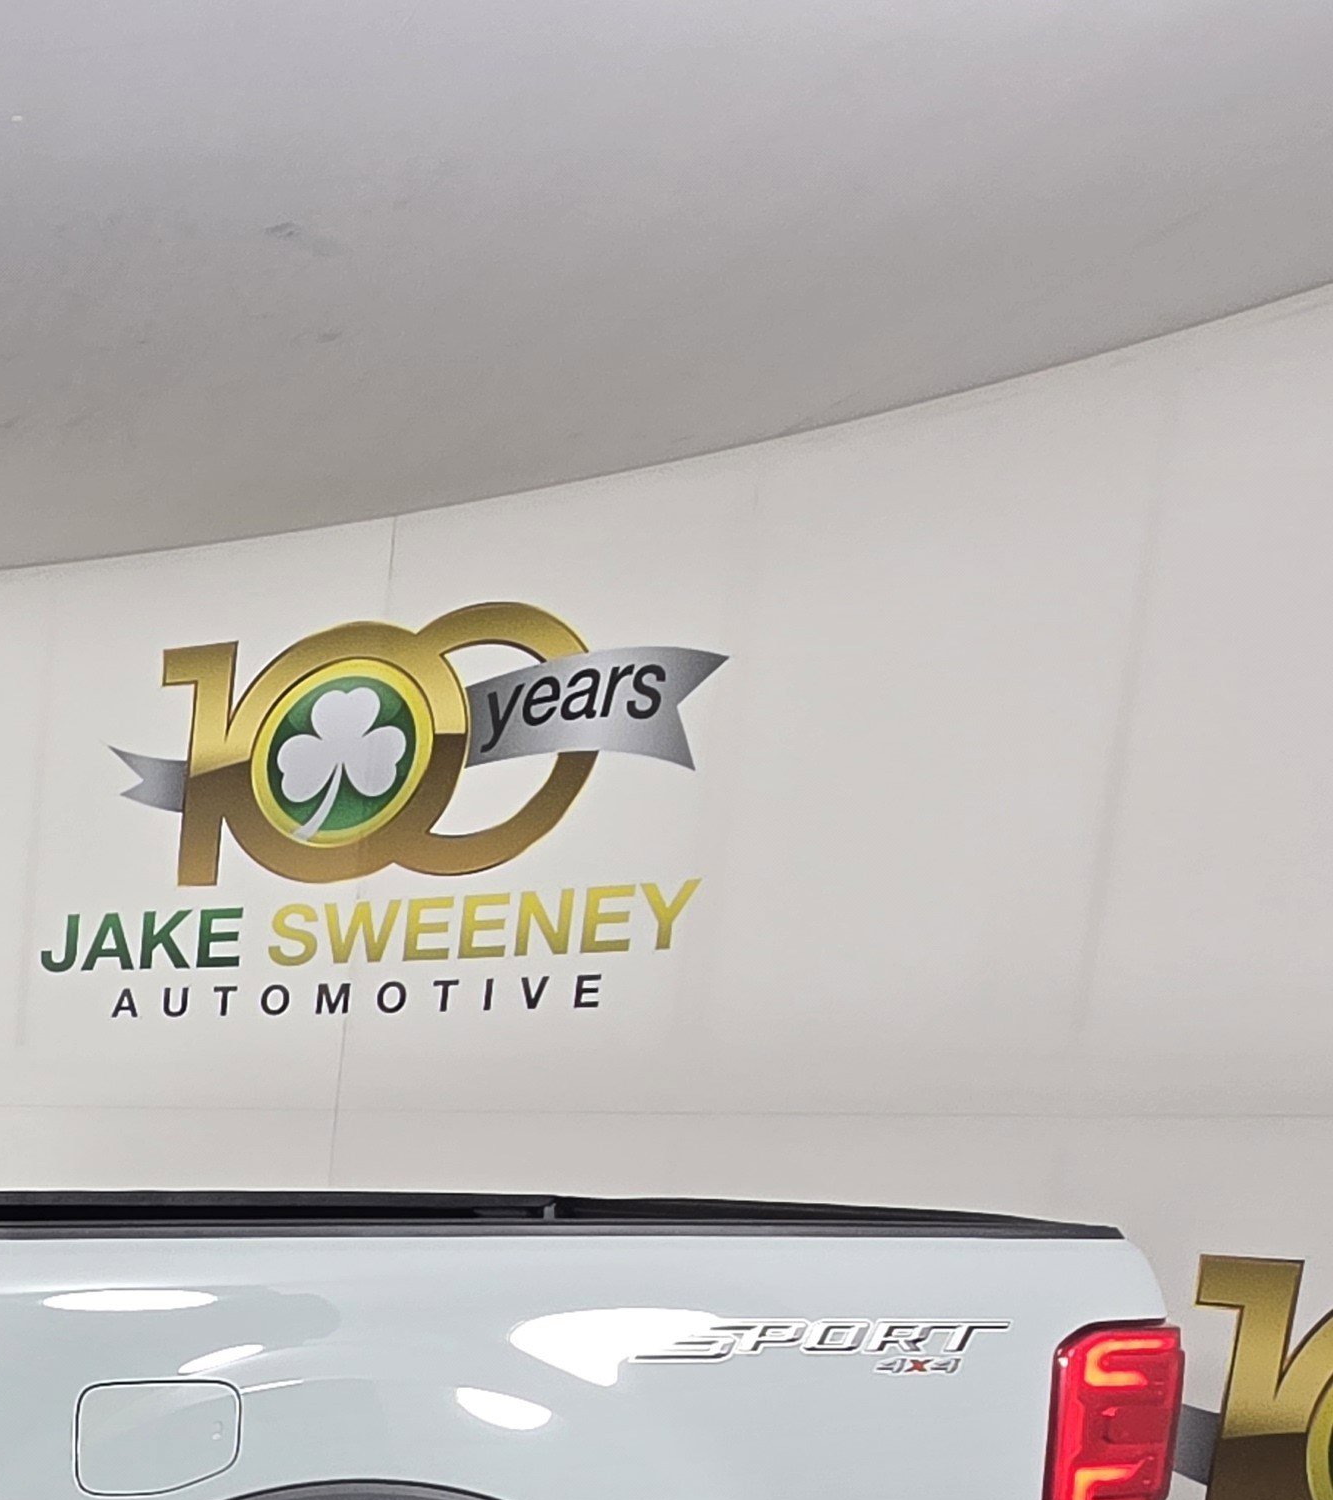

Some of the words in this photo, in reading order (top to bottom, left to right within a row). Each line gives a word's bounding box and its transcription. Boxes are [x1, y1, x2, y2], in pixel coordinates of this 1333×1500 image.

[162, 600, 599, 887] 100
[479, 662, 667, 752] years
[40, 906, 245, 973] JAKE
[267, 877, 703, 967] SWEENEY
[110, 973, 604, 1019] AUTOMOTIVE
[631, 1318, 1013, 1361] SPORT
